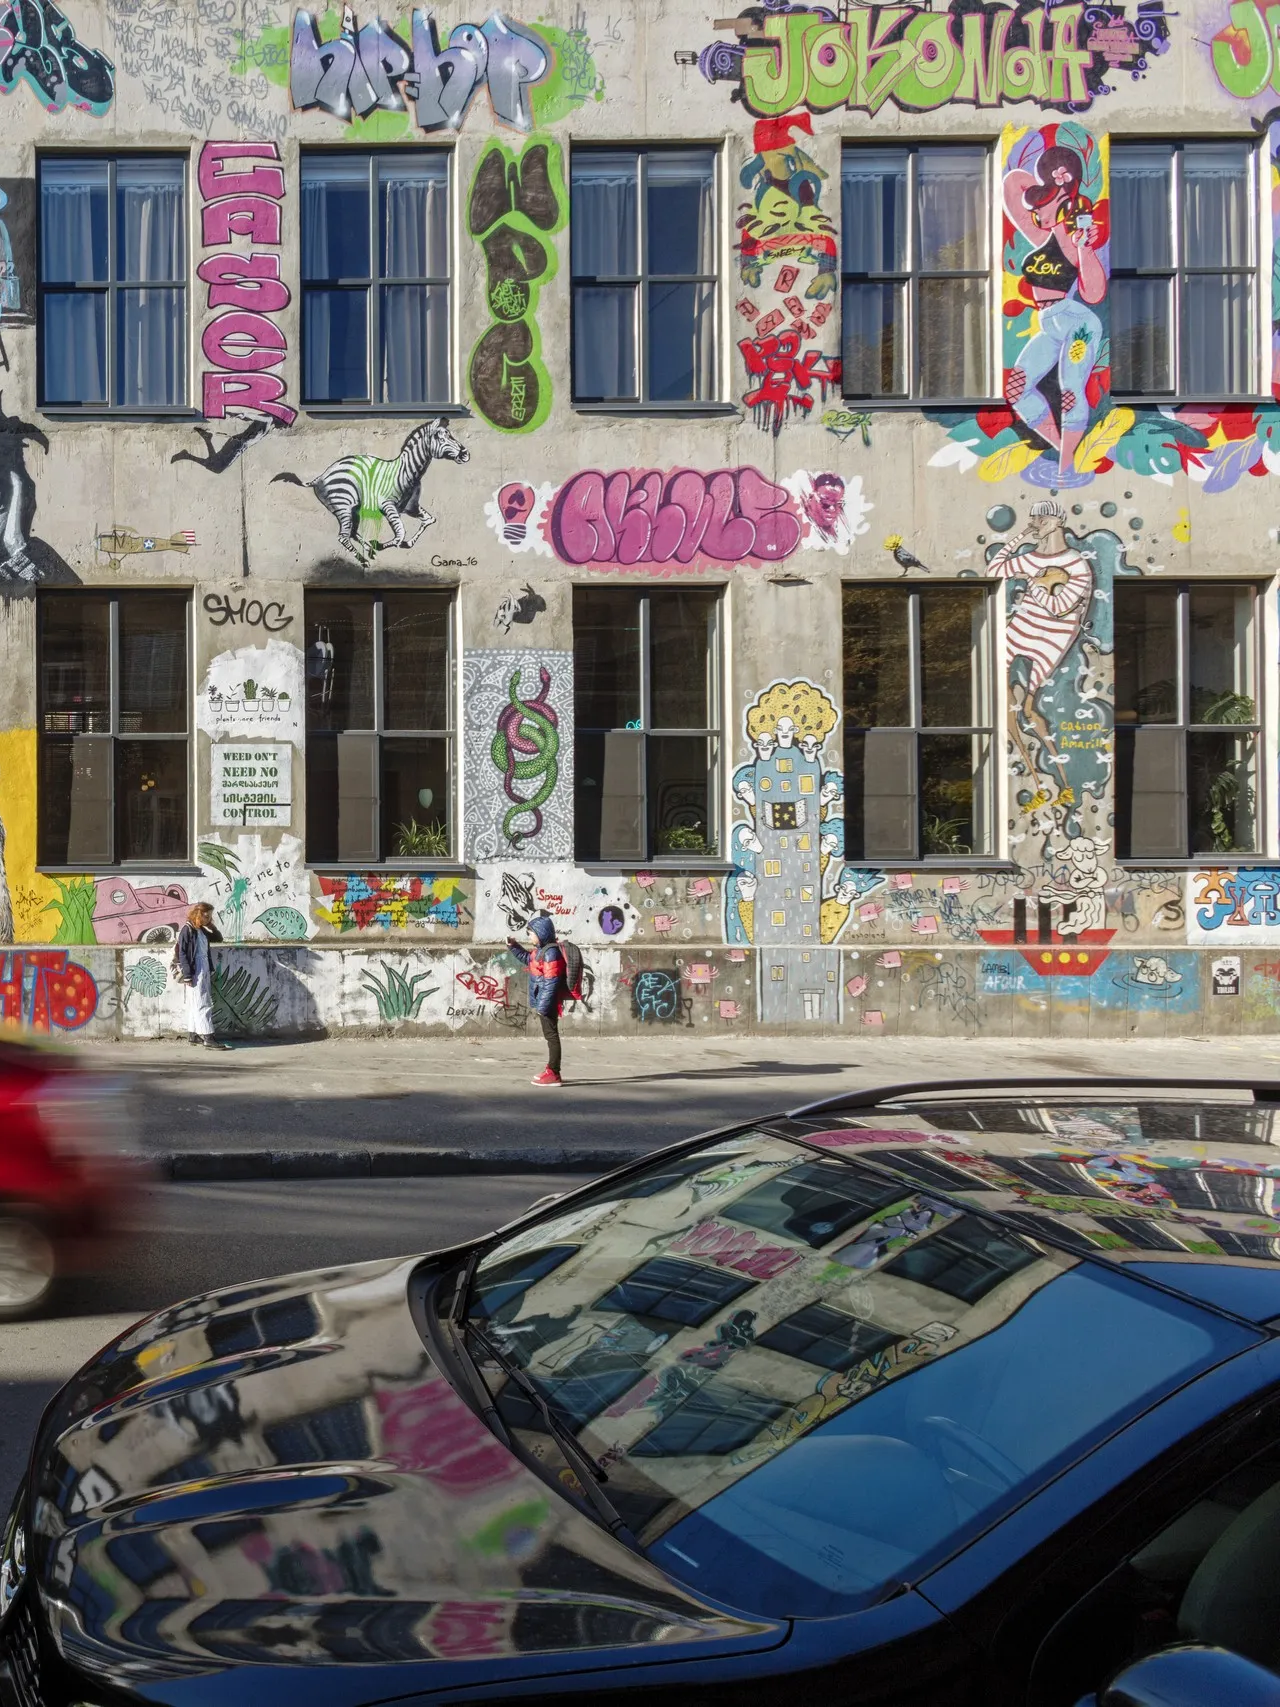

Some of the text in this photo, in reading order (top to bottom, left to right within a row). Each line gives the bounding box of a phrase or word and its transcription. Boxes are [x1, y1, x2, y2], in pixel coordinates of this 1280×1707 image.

[431, 554, 478, 567] Gama_16
[259, 714, 281, 722] friends
[223, 752, 252, 761] WEED
[222, 767, 278, 777] NEED NO
[223, 808, 277, 818] CONTROL
[257, 867, 273, 881] me
[275, 860, 290, 872] to
[254, 881, 289, 902] trees
